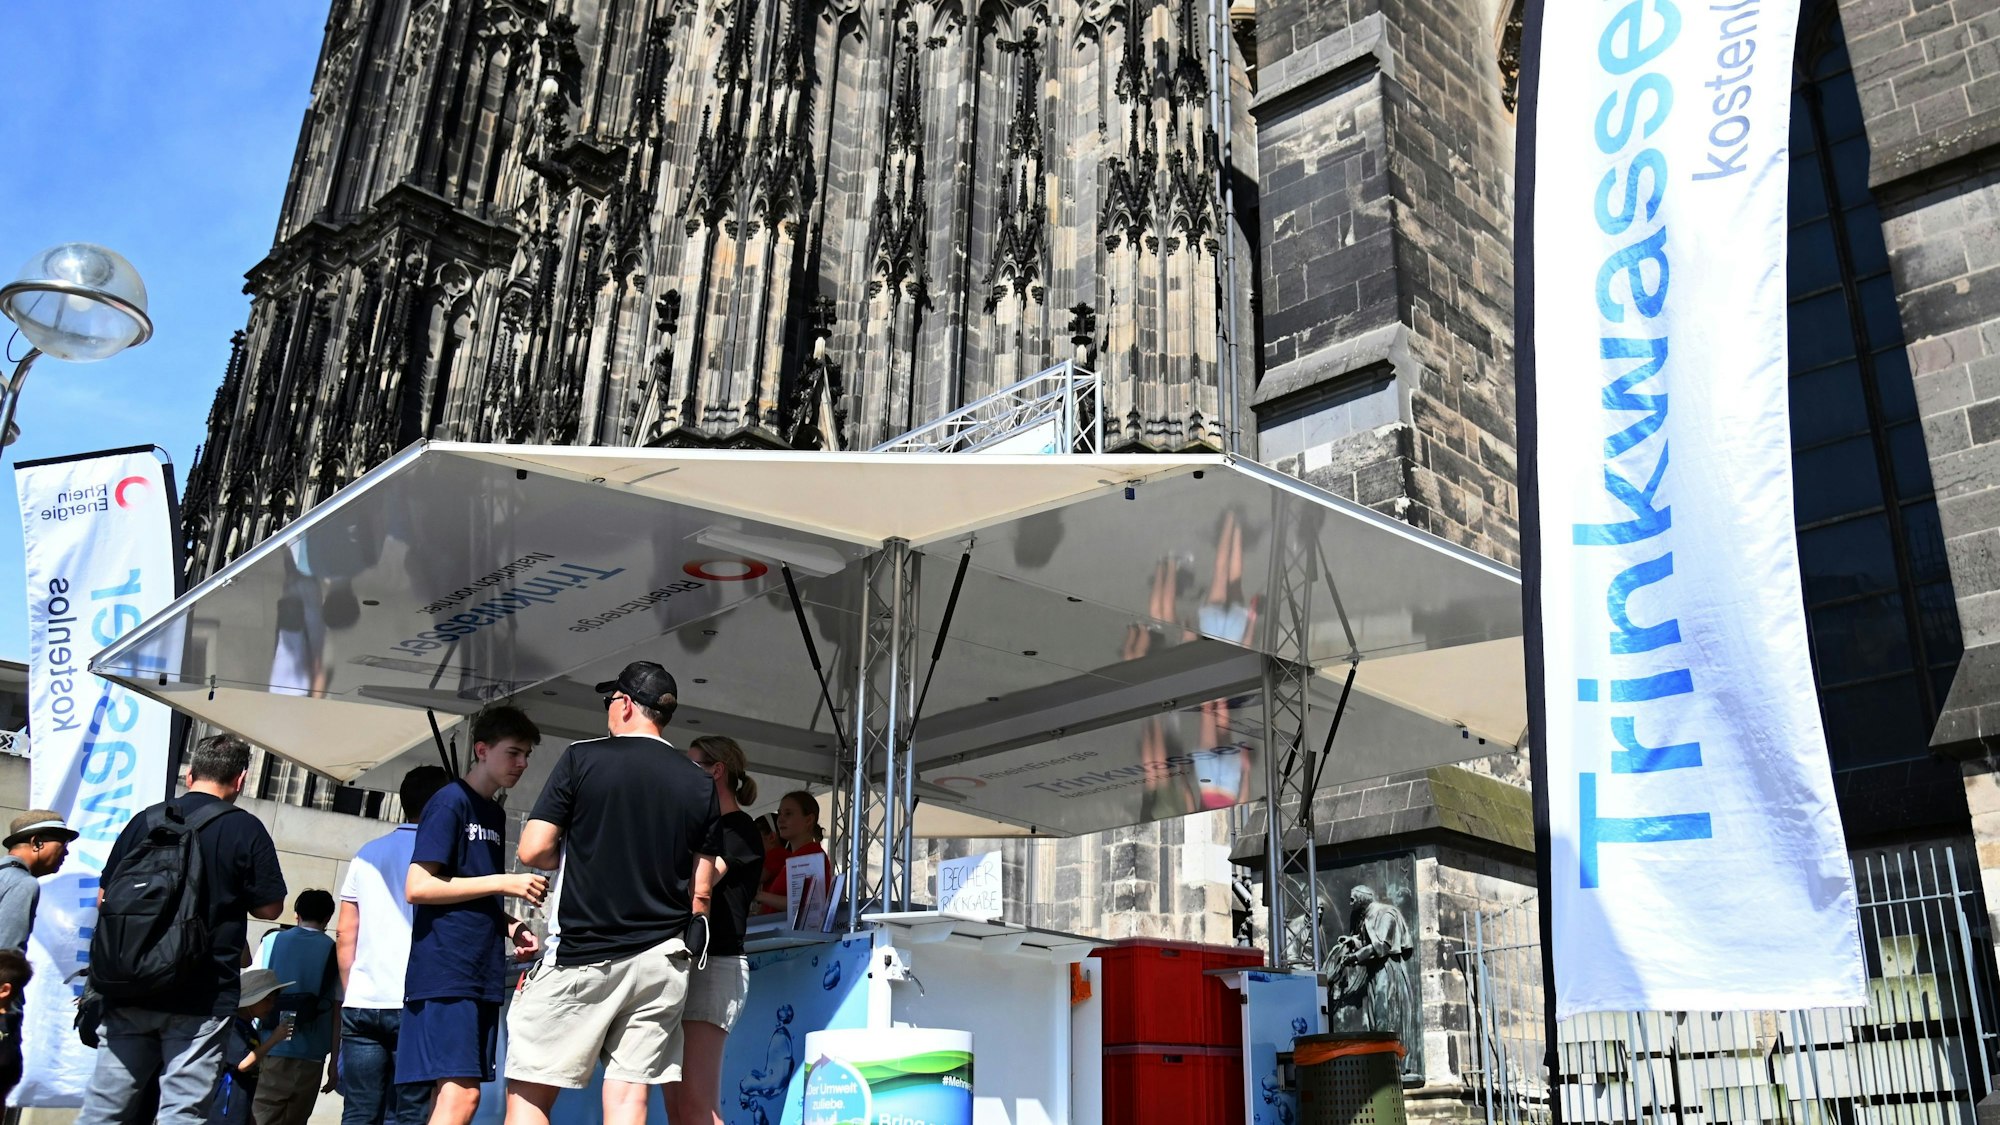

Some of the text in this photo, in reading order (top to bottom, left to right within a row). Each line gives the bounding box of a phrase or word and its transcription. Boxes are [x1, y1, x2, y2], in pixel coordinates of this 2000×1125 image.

[390, 563, 626, 656] Trinkwasser
[568, 580, 705, 633] RheinEnergie
[1022, 742, 1254, 793] Trinkwasser
[943, 861, 999, 891] BECHER
[820, 1081, 858, 1095] Umwelt
